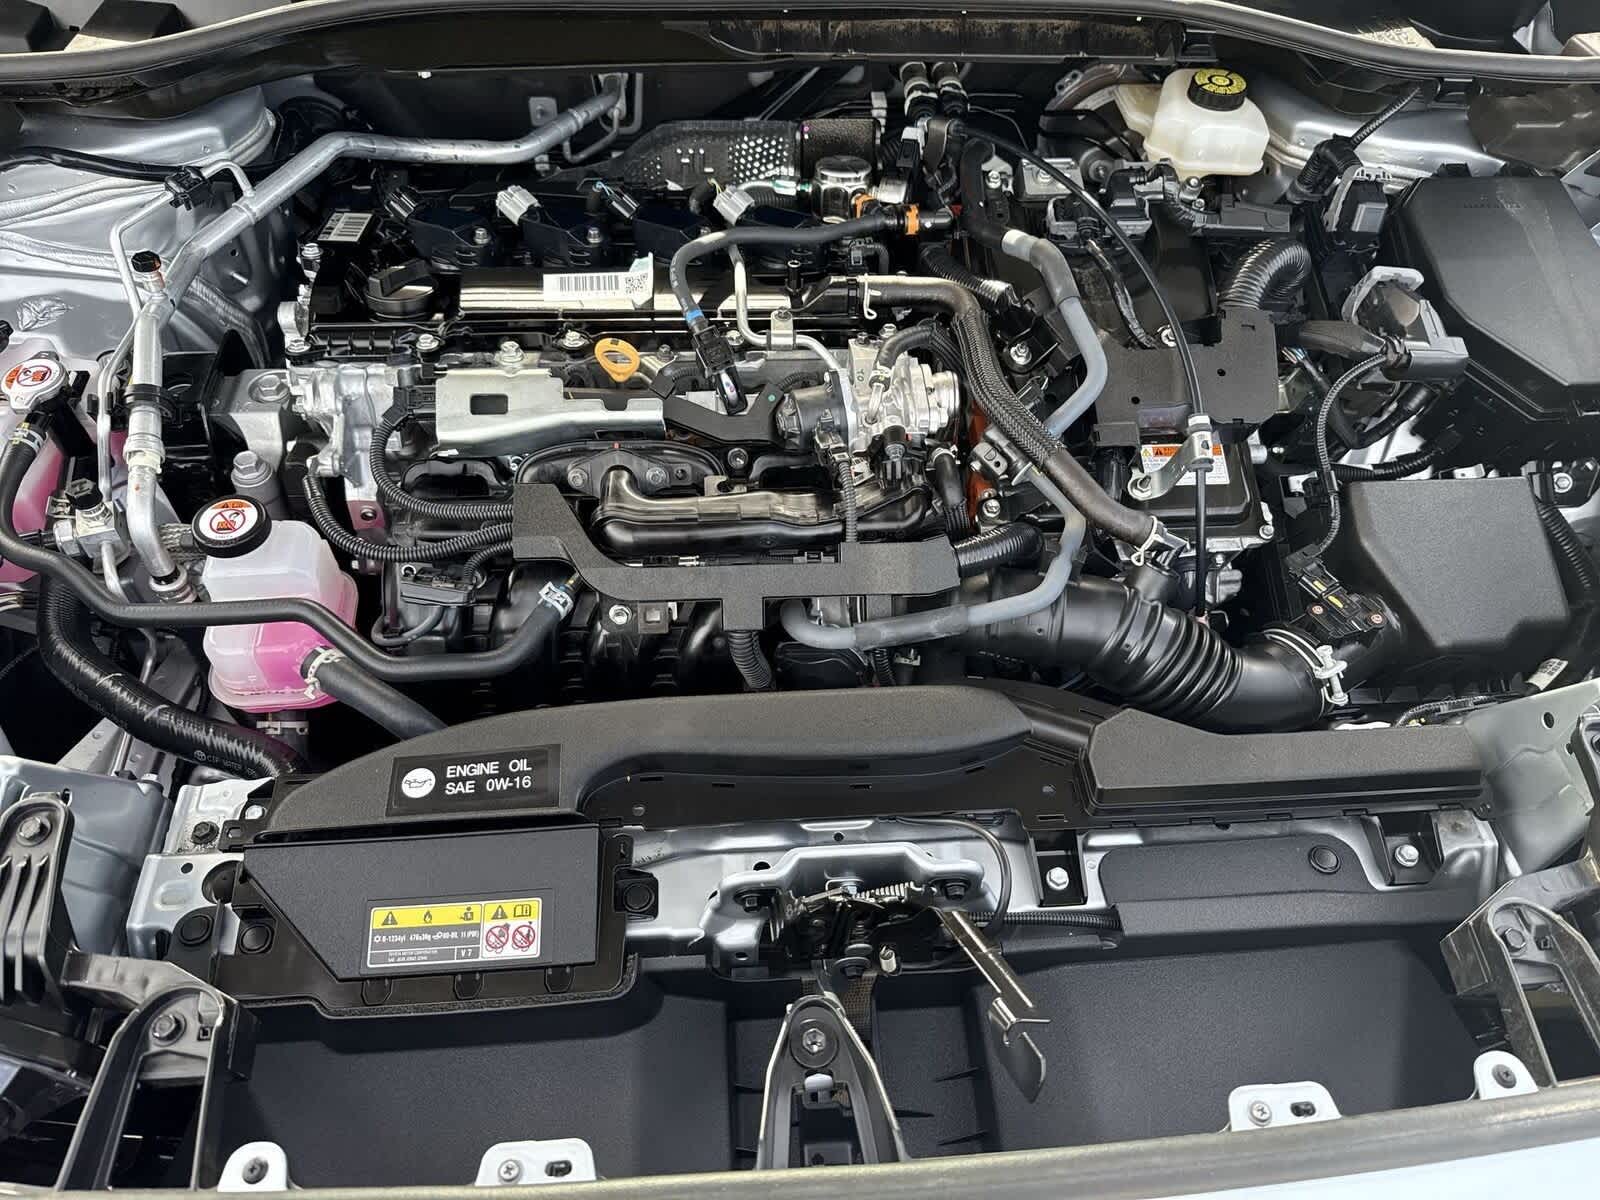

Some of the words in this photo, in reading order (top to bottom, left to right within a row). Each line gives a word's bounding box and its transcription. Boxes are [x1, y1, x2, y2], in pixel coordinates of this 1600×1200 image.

[446, 761, 500, 778] ENGINE
[508, 758, 532, 773] OIL
[444, 780, 476, 795] SAE
[486, 775, 532, 792] 0W-16
